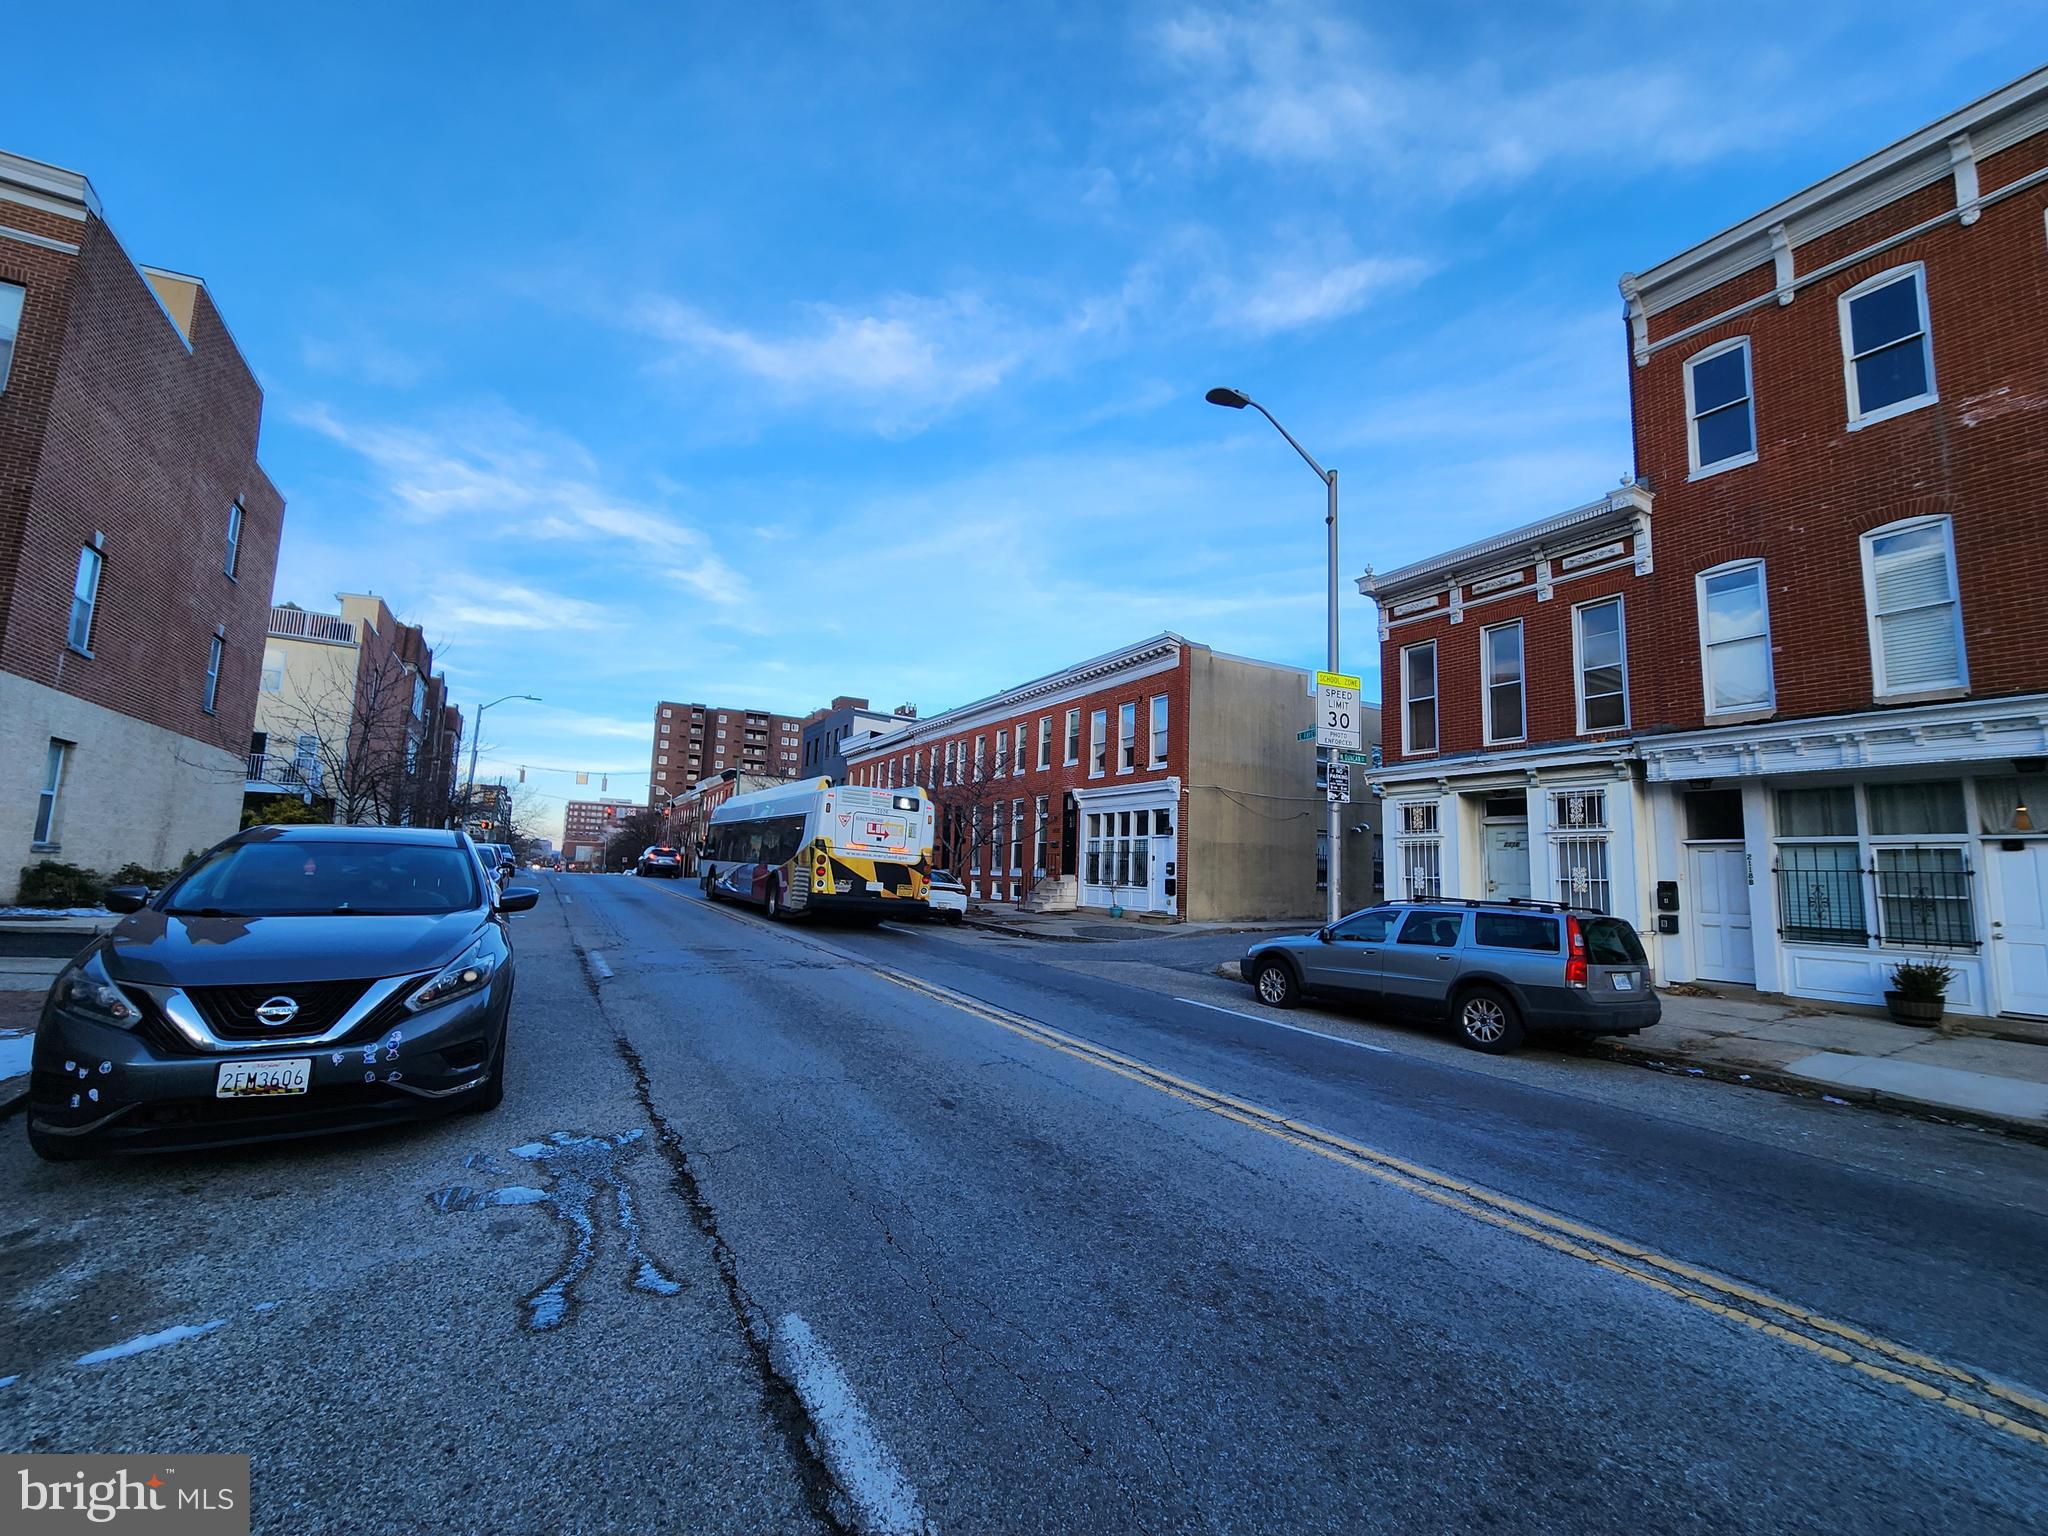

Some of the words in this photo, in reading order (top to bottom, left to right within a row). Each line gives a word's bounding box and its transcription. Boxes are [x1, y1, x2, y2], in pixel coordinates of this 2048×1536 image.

[1319, 674, 1341, 685] SCHOOL
[1344, 678, 1358, 687] ZONE
[1325, 688, 1353, 700] SPEED
[1328, 701, 1350, 711] LIMIT
[1328, 711, 1350, 729] 30
[1329, 731, 1348, 739] PHOTO
[1324, 738, 1353, 747] ENFORCED
[222, 1069, 303, 1090] 2FM3606
